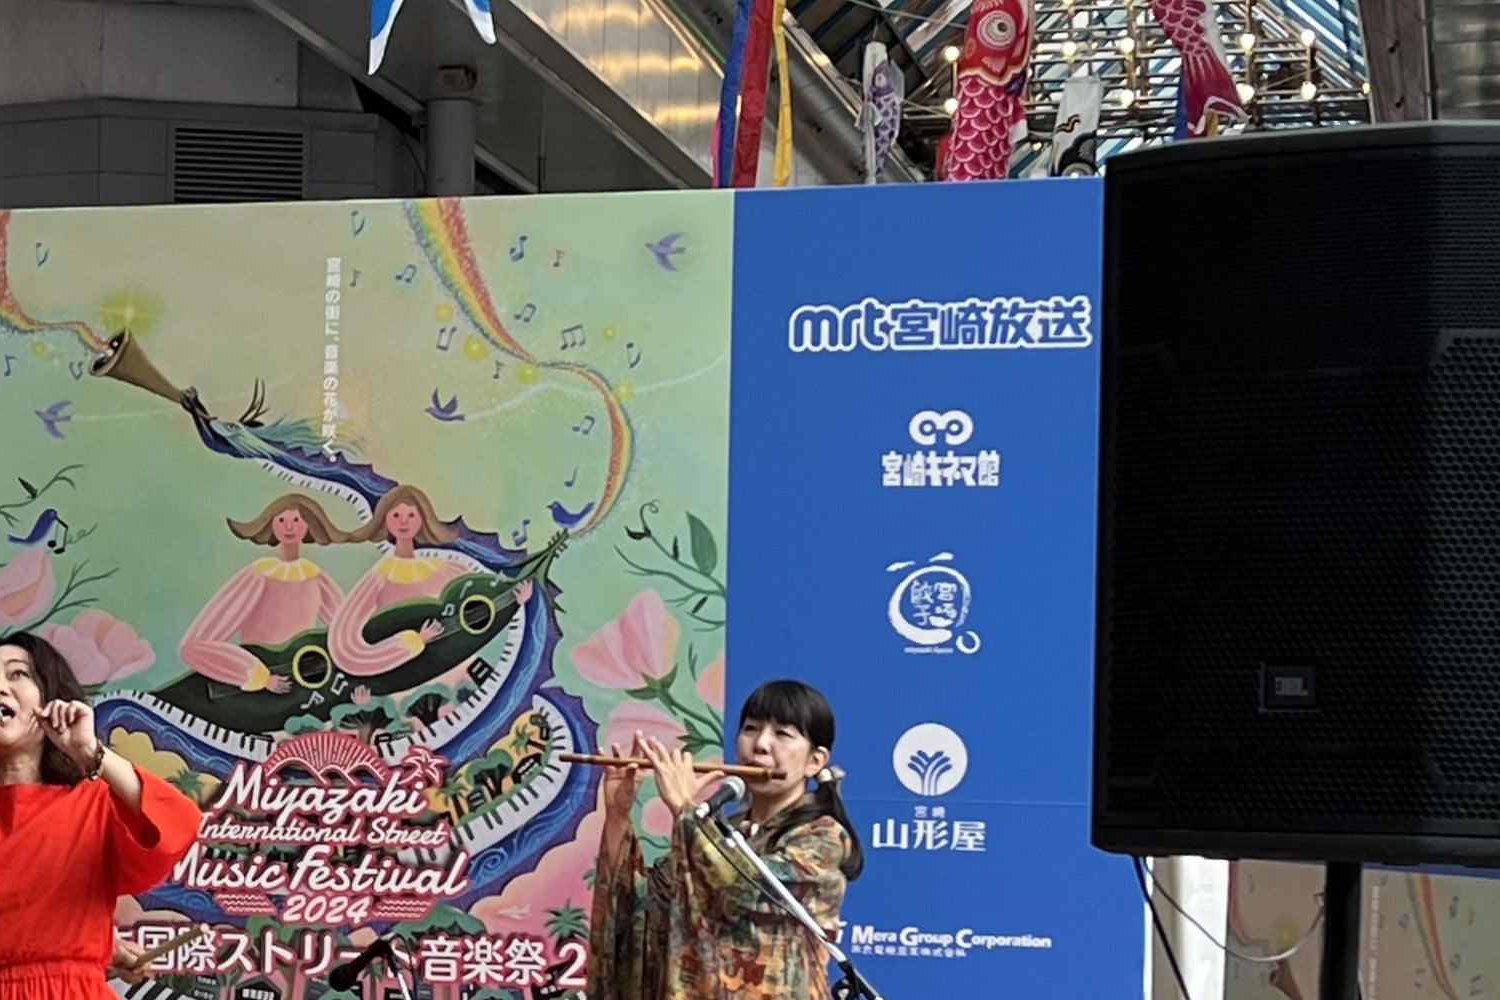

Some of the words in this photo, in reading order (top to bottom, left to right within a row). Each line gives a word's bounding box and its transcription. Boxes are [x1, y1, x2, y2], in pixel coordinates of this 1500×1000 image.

[213, 764, 428, 827] Miyazaki
[197, 812, 361, 844] International
[367, 816, 448, 847] Street
[872, 819, 987, 852] 山形屋
[173, 842, 288, 890] Music
[282, 895, 372, 924] 2024
[899, 926, 954, 947] Group
[956, 928, 1052, 949] Corporation
